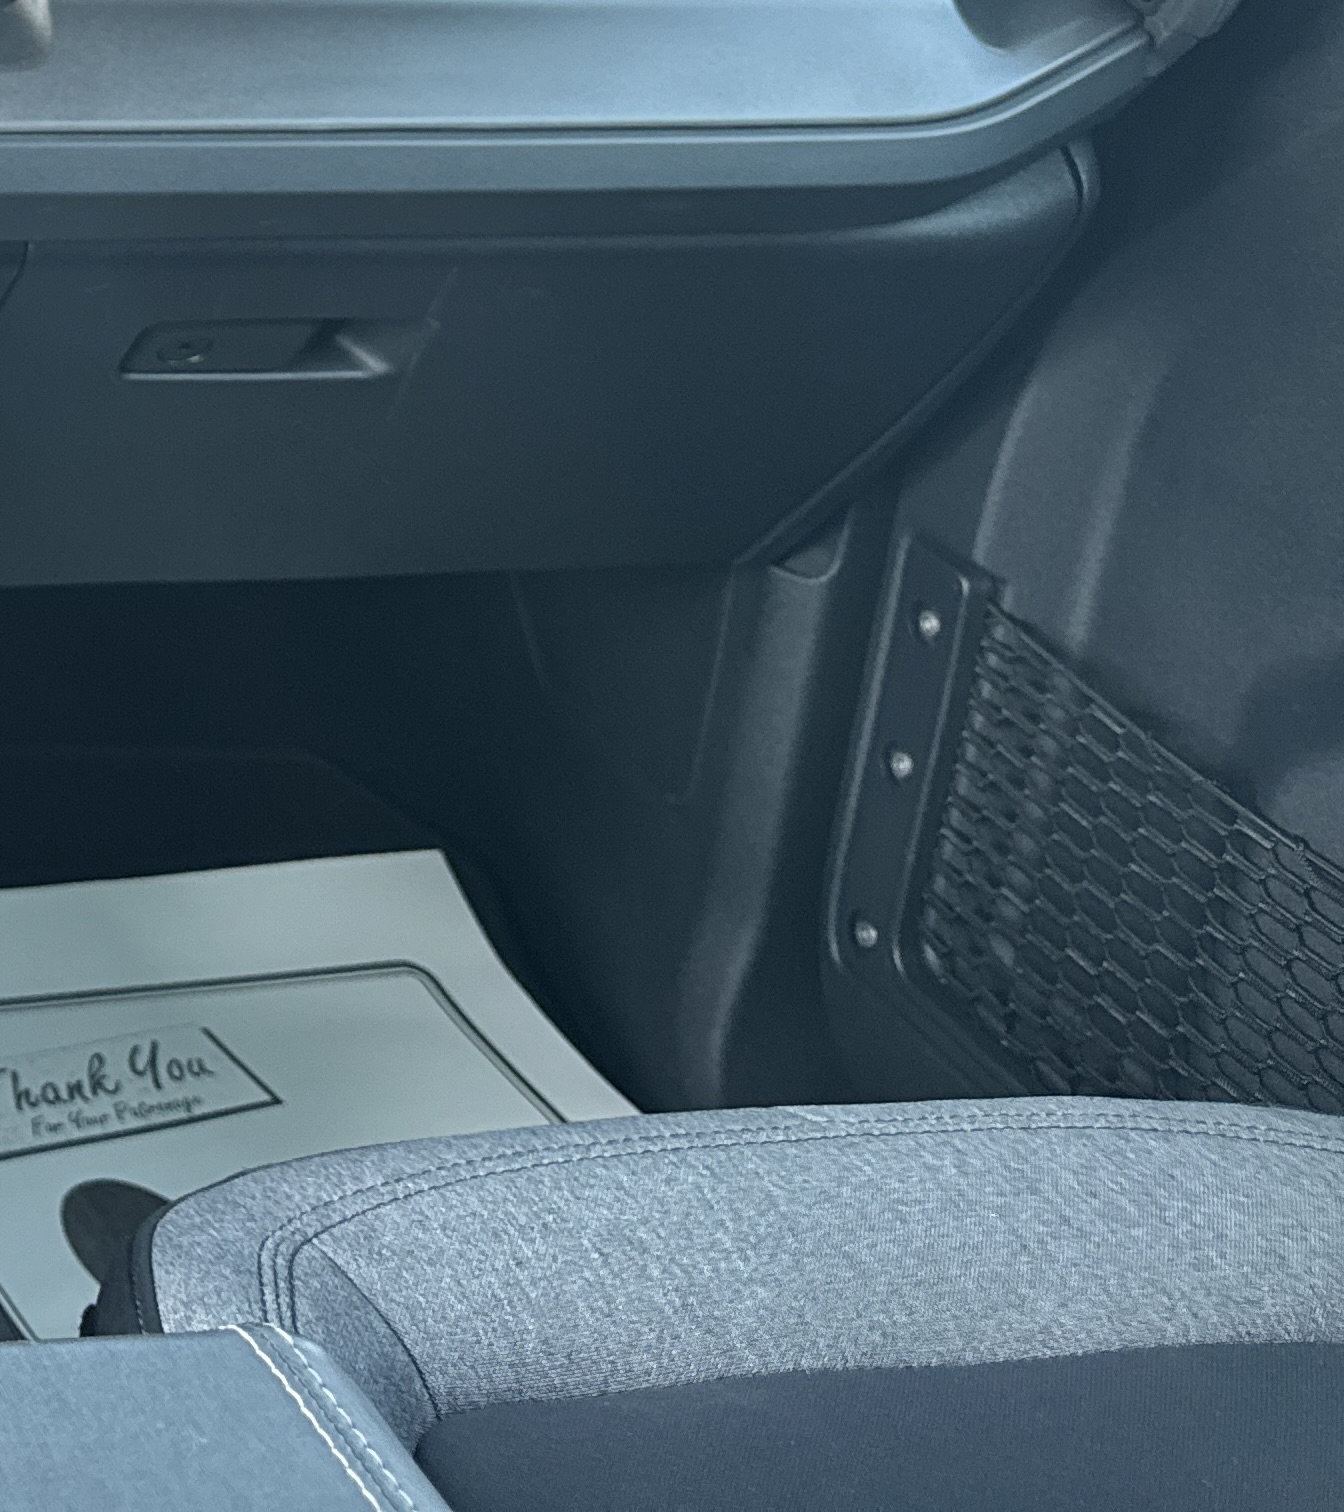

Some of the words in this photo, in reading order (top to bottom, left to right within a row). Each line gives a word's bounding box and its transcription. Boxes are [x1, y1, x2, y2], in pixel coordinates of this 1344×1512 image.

[127, 1039, 215, 1090] You
[30, 1114, 65, 1137] For
[67, 1109, 110, 1132] Your
